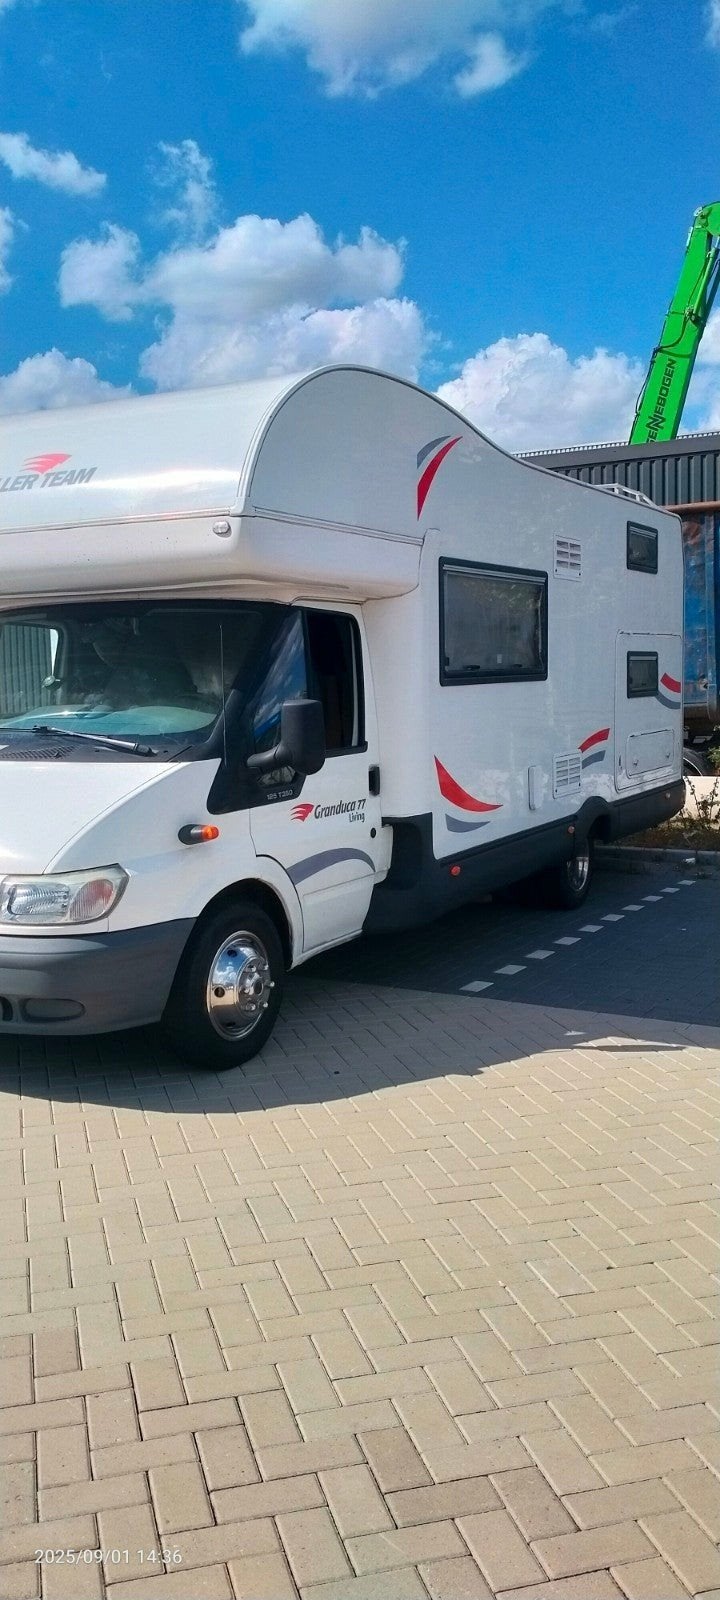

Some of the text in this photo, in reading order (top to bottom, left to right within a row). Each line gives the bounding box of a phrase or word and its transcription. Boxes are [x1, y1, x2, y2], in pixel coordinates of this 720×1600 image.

[40, 467, 98, 488] TEAM
[314, 799, 367, 819] Granduca 77
[349, 812, 365, 823] Living
